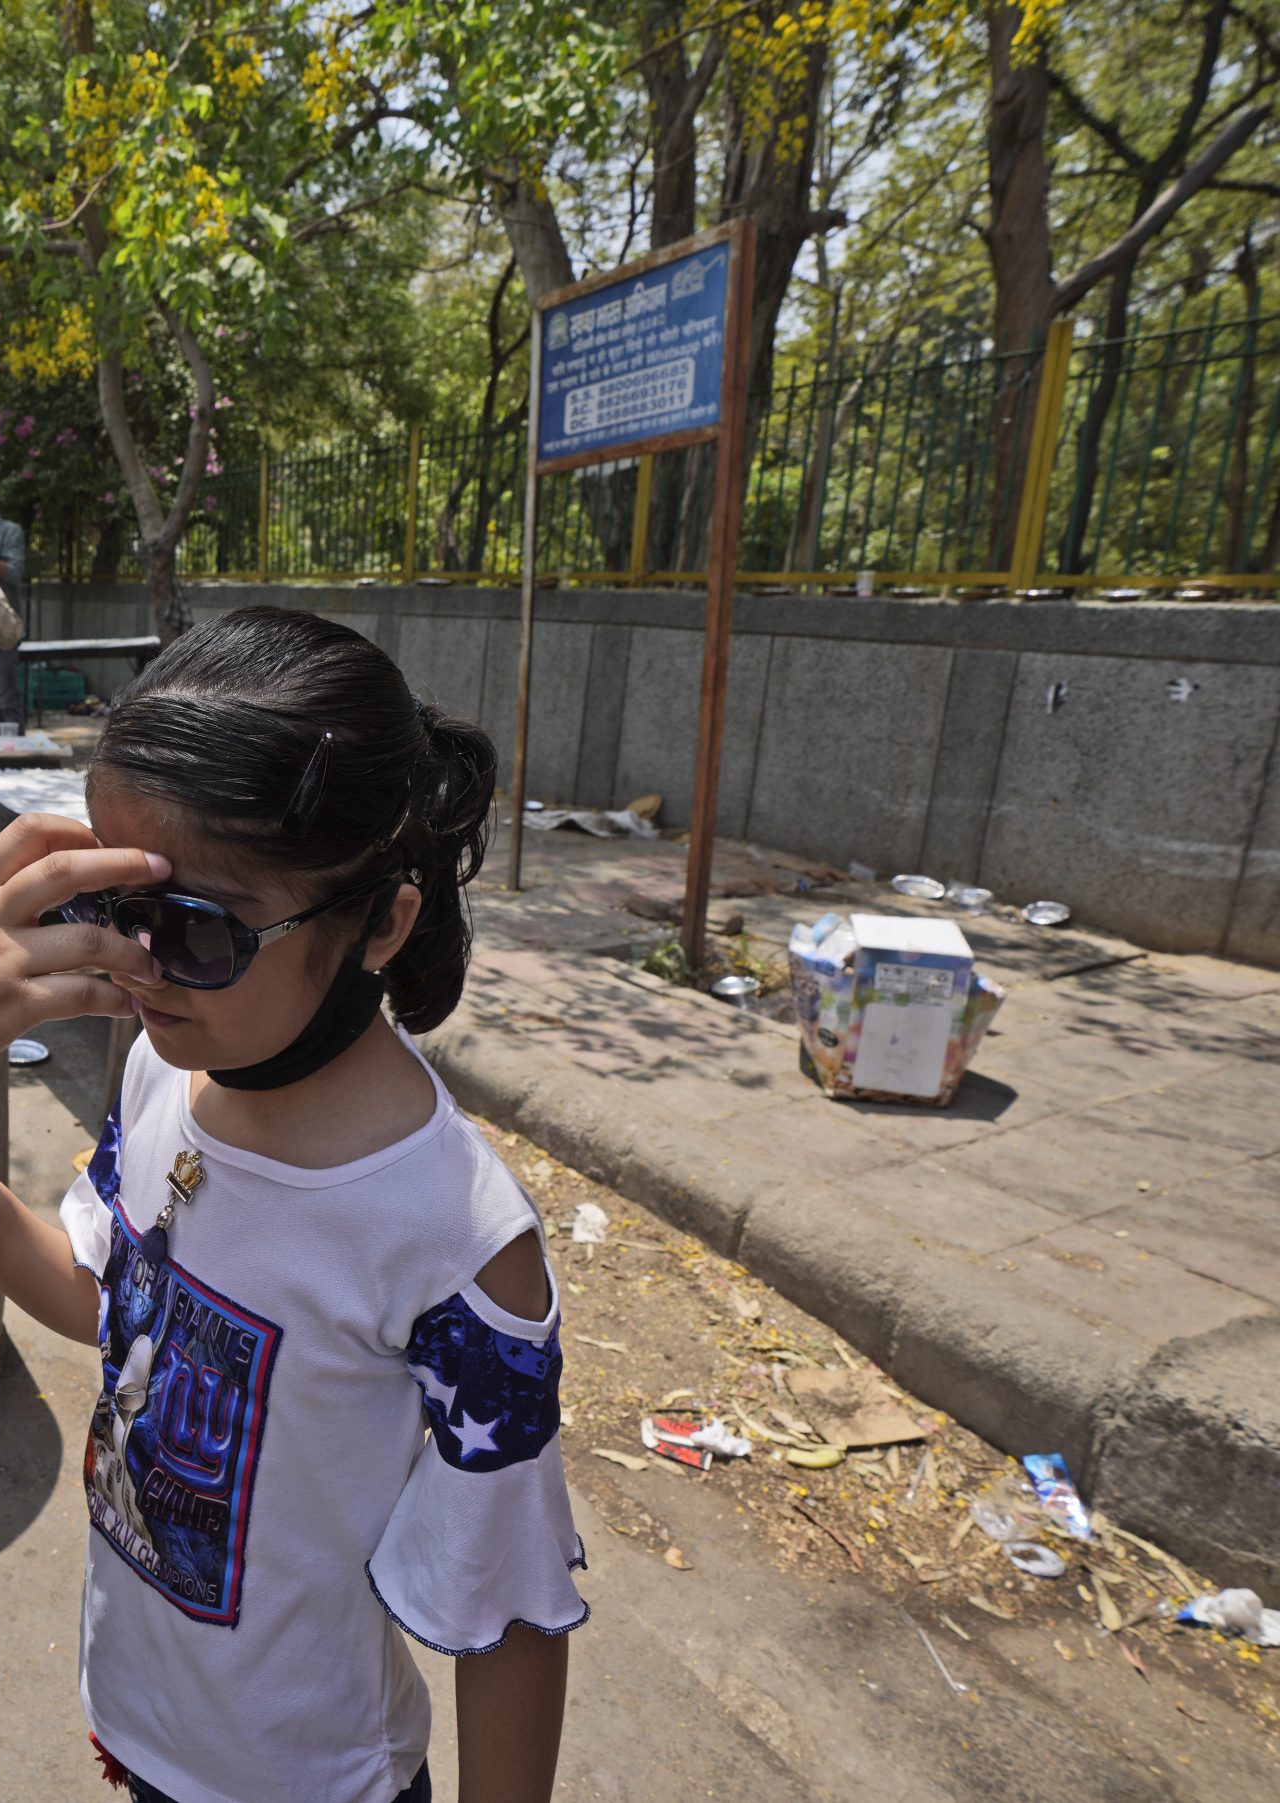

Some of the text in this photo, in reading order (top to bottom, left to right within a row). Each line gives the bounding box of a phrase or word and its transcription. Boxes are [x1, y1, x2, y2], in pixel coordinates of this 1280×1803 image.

[597, 299, 622, 328] भारत
[623, 282, 667, 320] अभियान
[174, 1288, 256, 1364] GIANTS
[138, 1542, 217, 1603] CHAMPIONS
